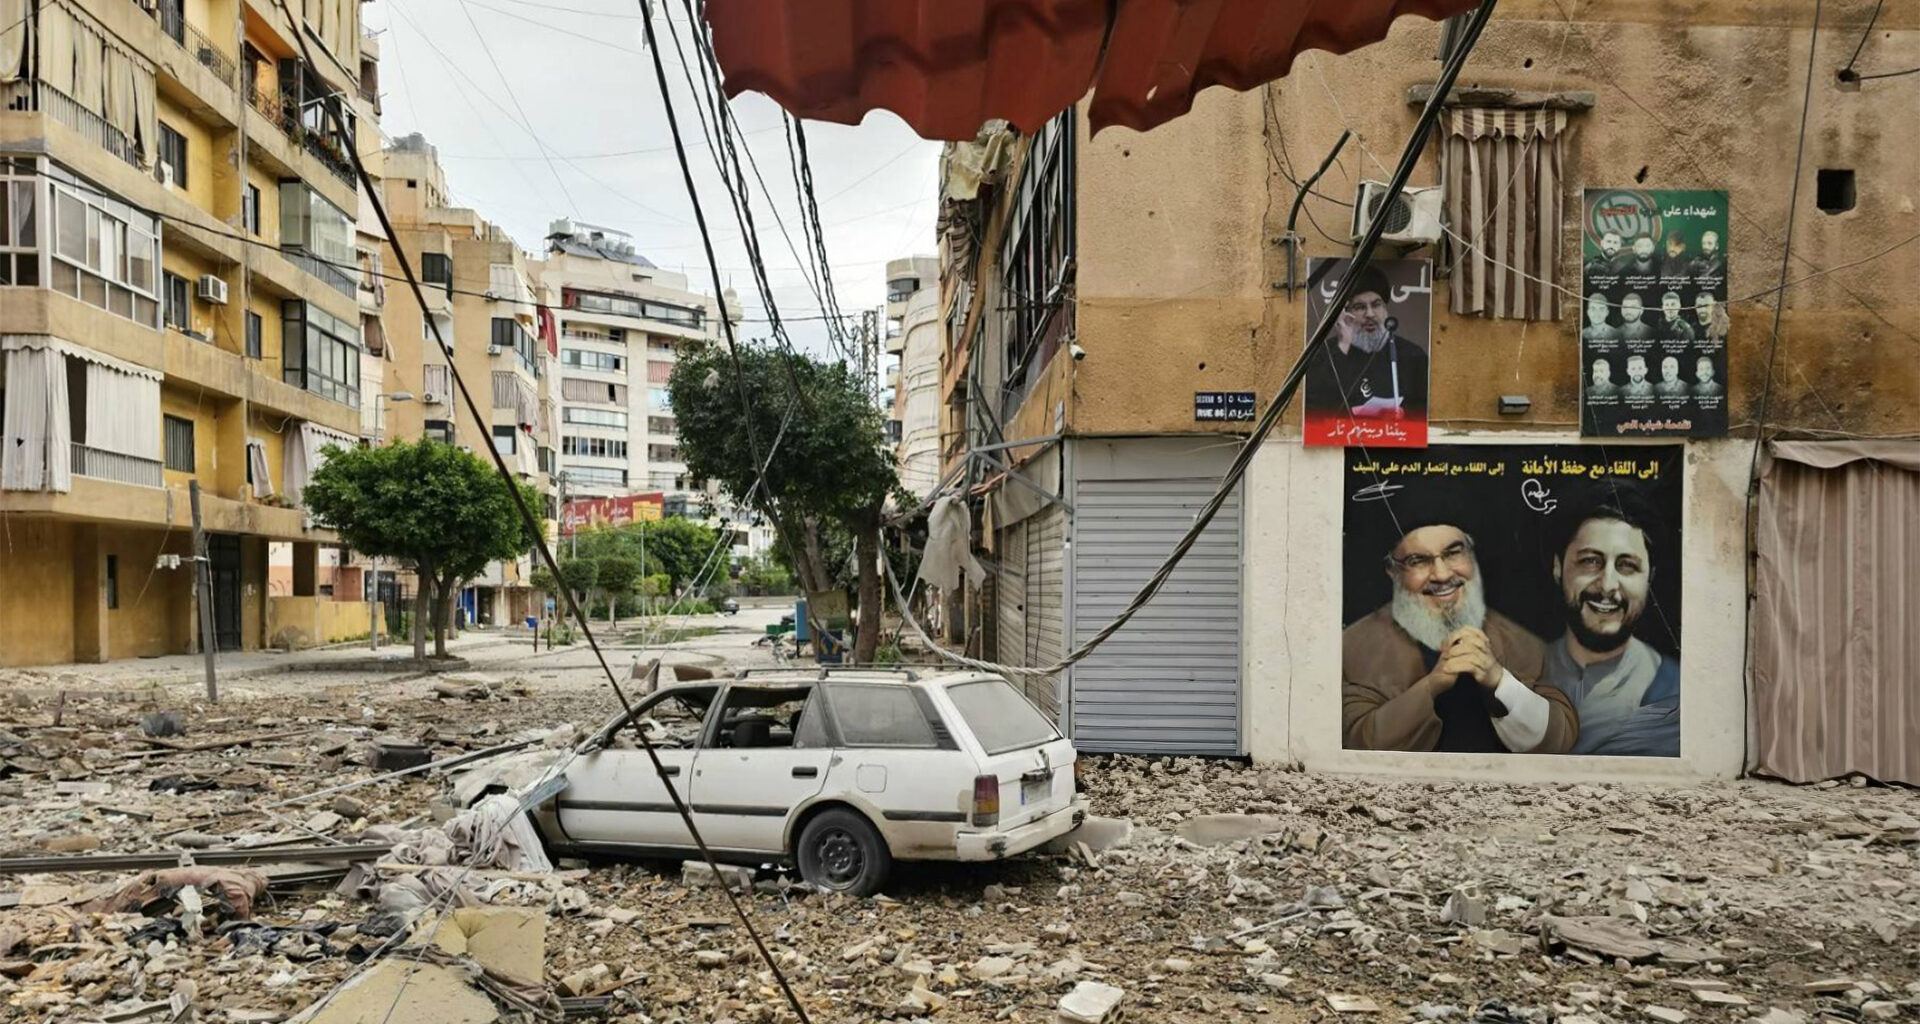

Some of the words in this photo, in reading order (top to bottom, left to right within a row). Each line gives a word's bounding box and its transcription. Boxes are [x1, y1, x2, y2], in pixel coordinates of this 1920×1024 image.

[1663, 205, 1681, 217] على
[1683, 205, 1716, 218] شهداء
[1197, 409, 1213, 417] RUE
[1352, 461, 1380, 474] السيف
[1381, 462, 1400, 475] على
[1401, 462, 1421, 474] الدم
[1450, 465, 1463, 475] مع
[1464, 462, 1487, 473] اللقاء
[1488, 462, 1505, 476] إلى
[1521, 455, 1558, 475] الأمانة
[1560, 459, 1587, 475] حفظ
[1589, 464, 1605, 479] مع
[1607, 460, 1636, 475] اللقاء
[1638, 460, 1659, 479] إلى
